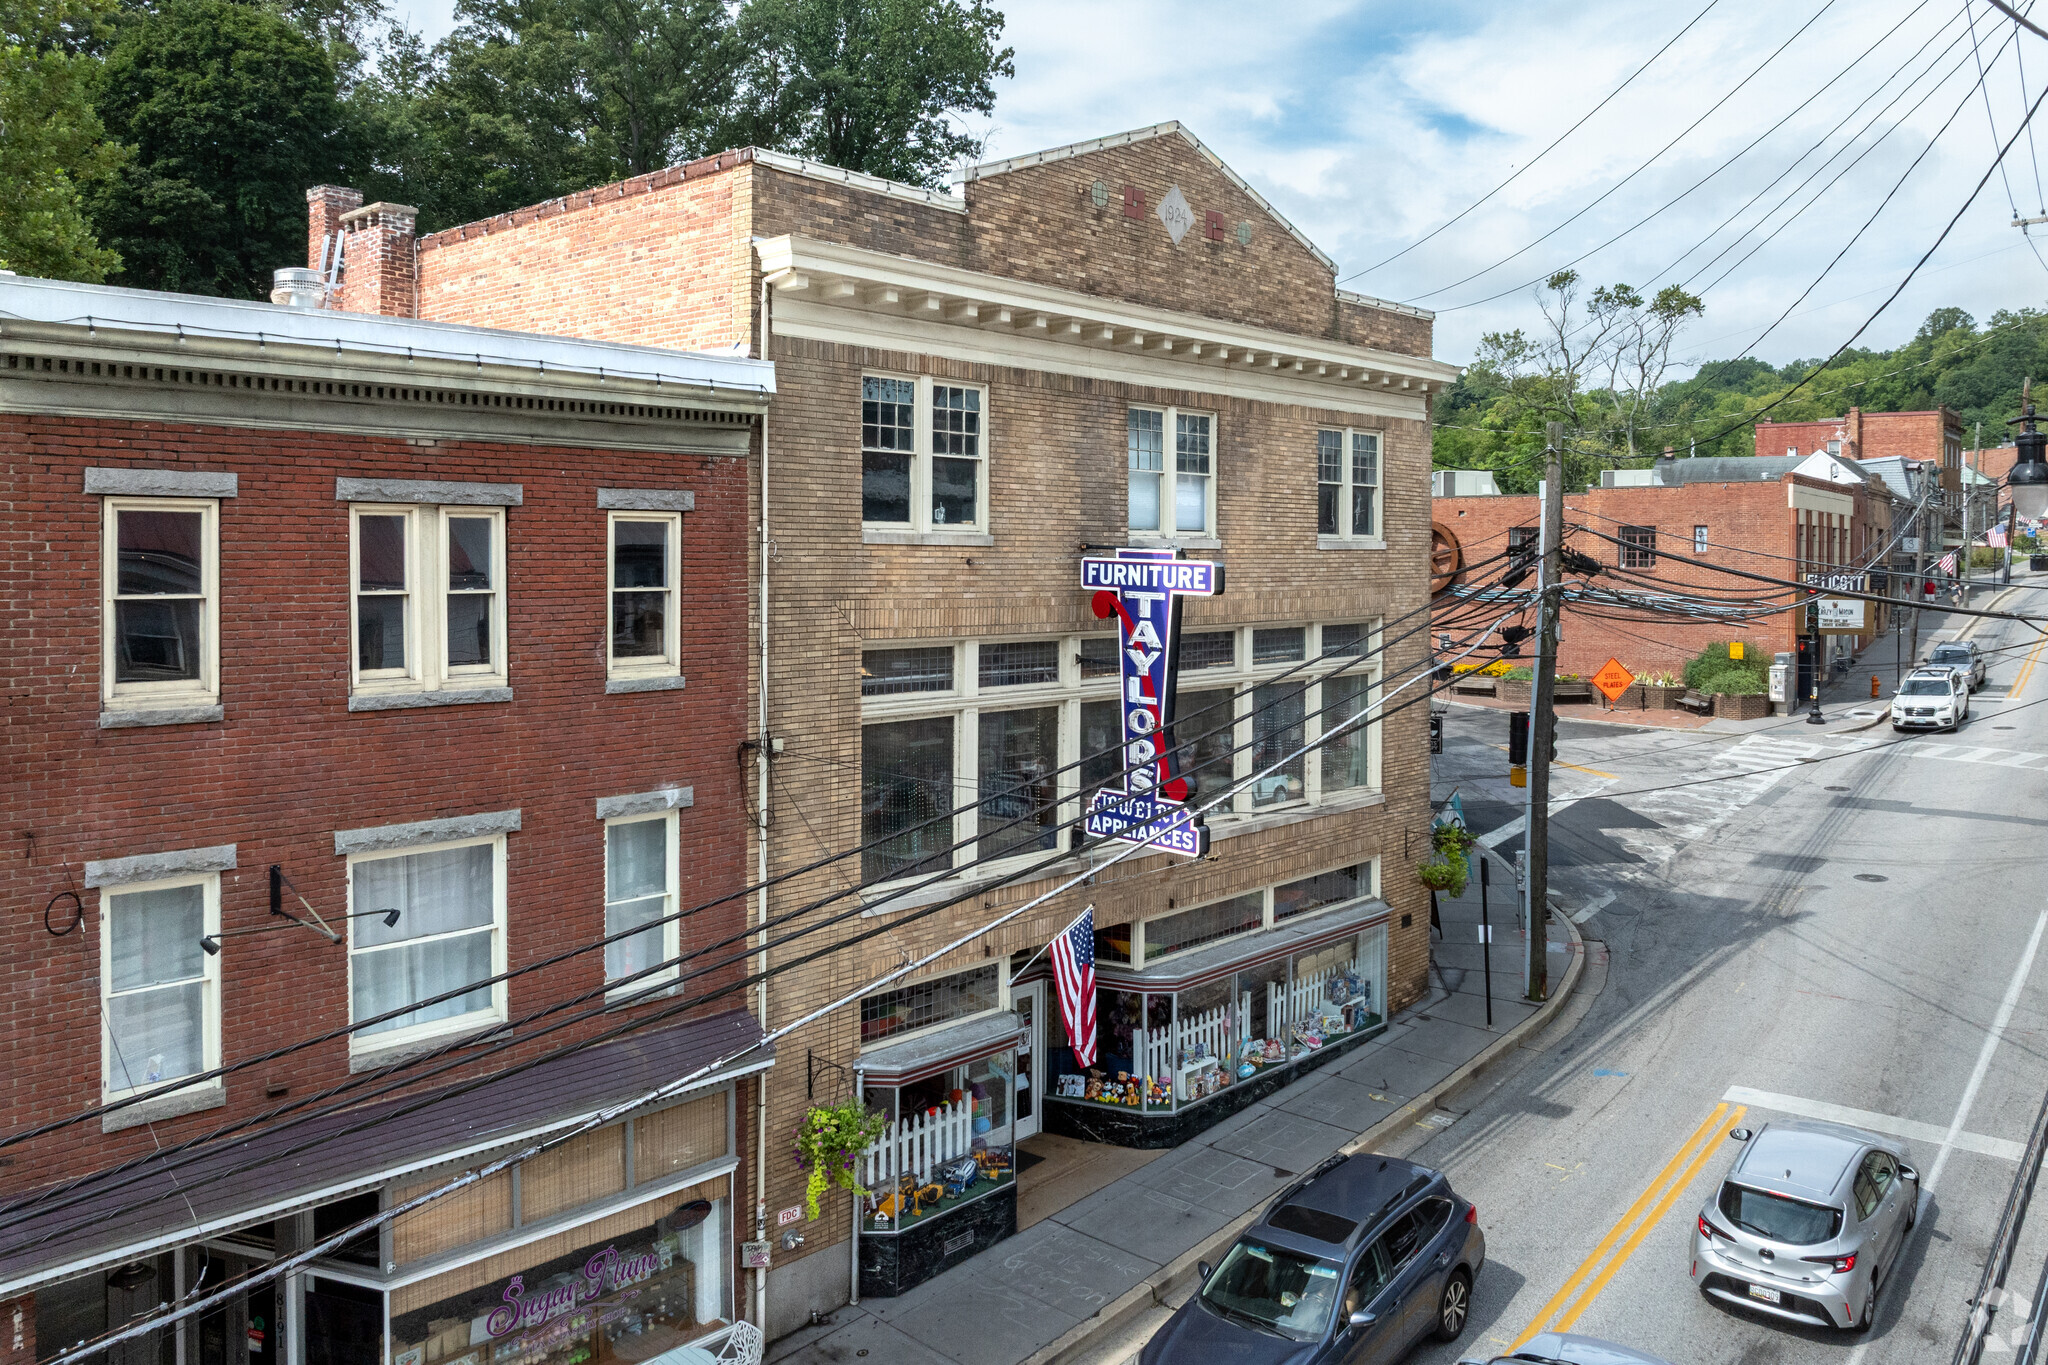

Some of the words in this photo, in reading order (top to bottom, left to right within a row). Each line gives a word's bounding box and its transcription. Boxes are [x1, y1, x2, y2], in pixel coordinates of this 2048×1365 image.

[1164, 204, 1187, 225] 1924
[1087, 562, 1206, 590] FURNITURE
[1602, 681, 1623, 689] PLATES
[1604, 672, 1621, 680] STEEL
[1123, 591, 1166, 796] TAYLORS
[781, 1208, 798, 1222] FDC
[486, 1278, 582, 1337] Sugar
[584, 1244, 658, 1300] Plum
[276, 1293, 285, 1349] 8191
[598, 1306, 627, 1326] SHOP
